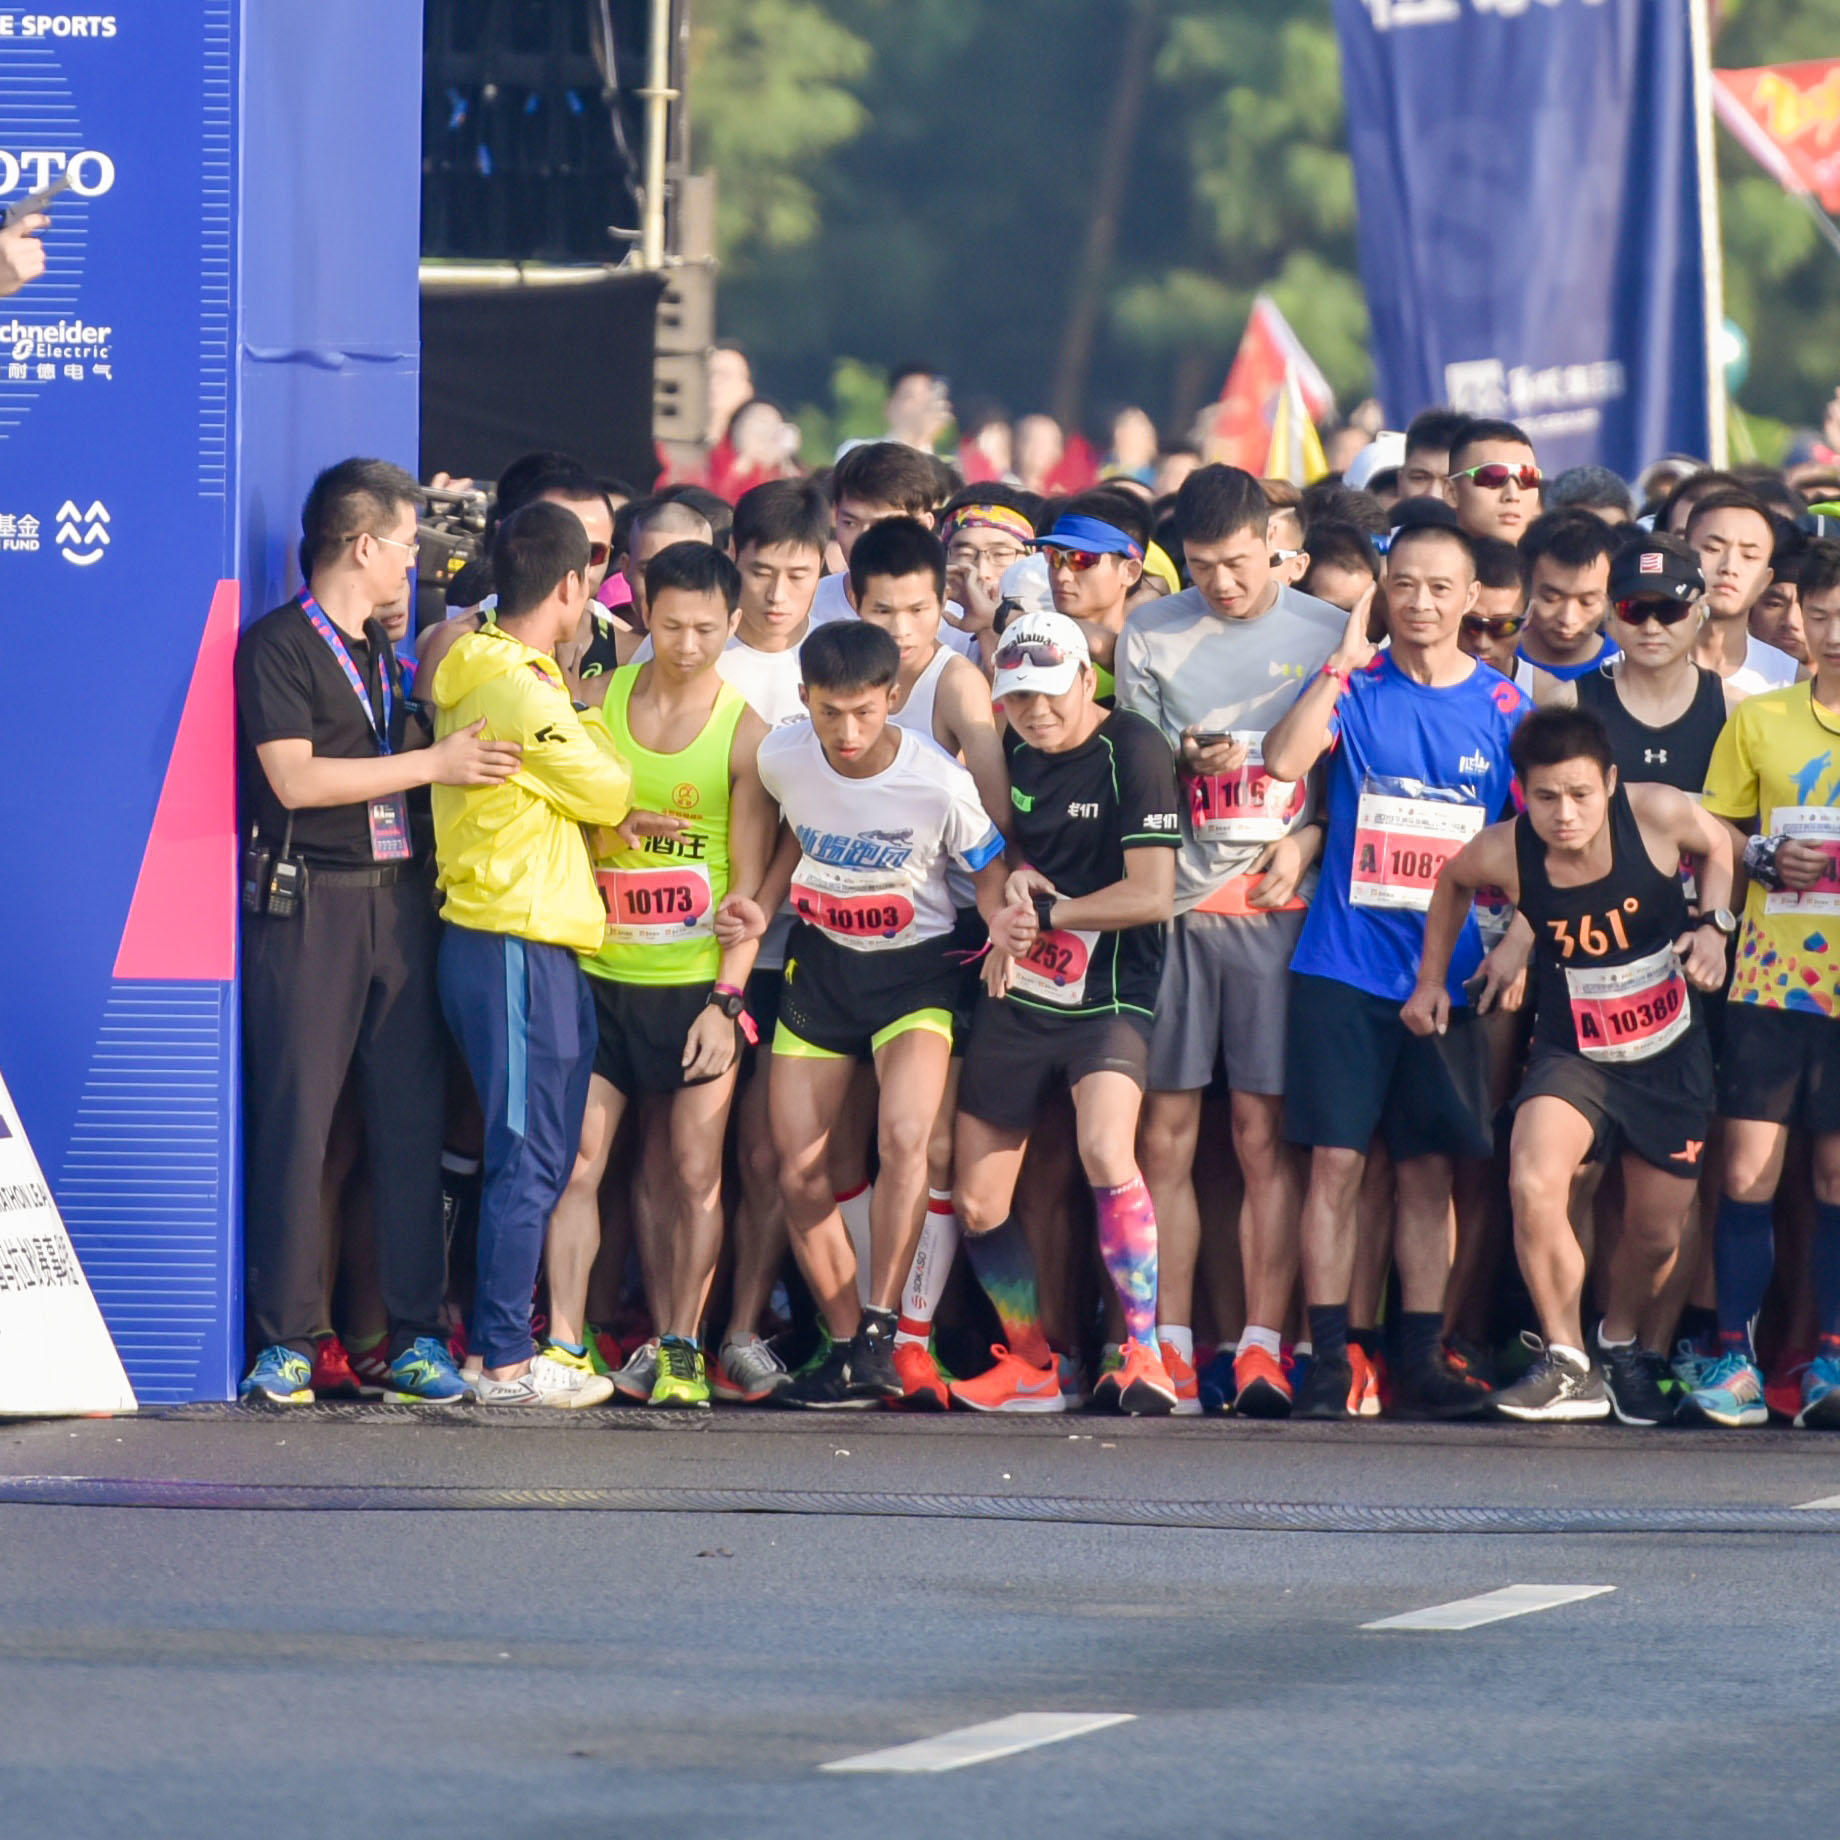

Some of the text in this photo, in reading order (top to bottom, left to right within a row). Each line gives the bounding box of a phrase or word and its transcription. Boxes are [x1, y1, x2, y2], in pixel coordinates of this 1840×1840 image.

[22, 15, 117, 38] SPORTS
[36, 344, 109, 358] Electric
[3, 539, 40, 551] FUND
[1360, 843, 1376, 873] A
[624, 886, 693, 914] 10173
[826, 906, 899, 929] 10103
[1581, 989, 1679, 1038] A 10380
